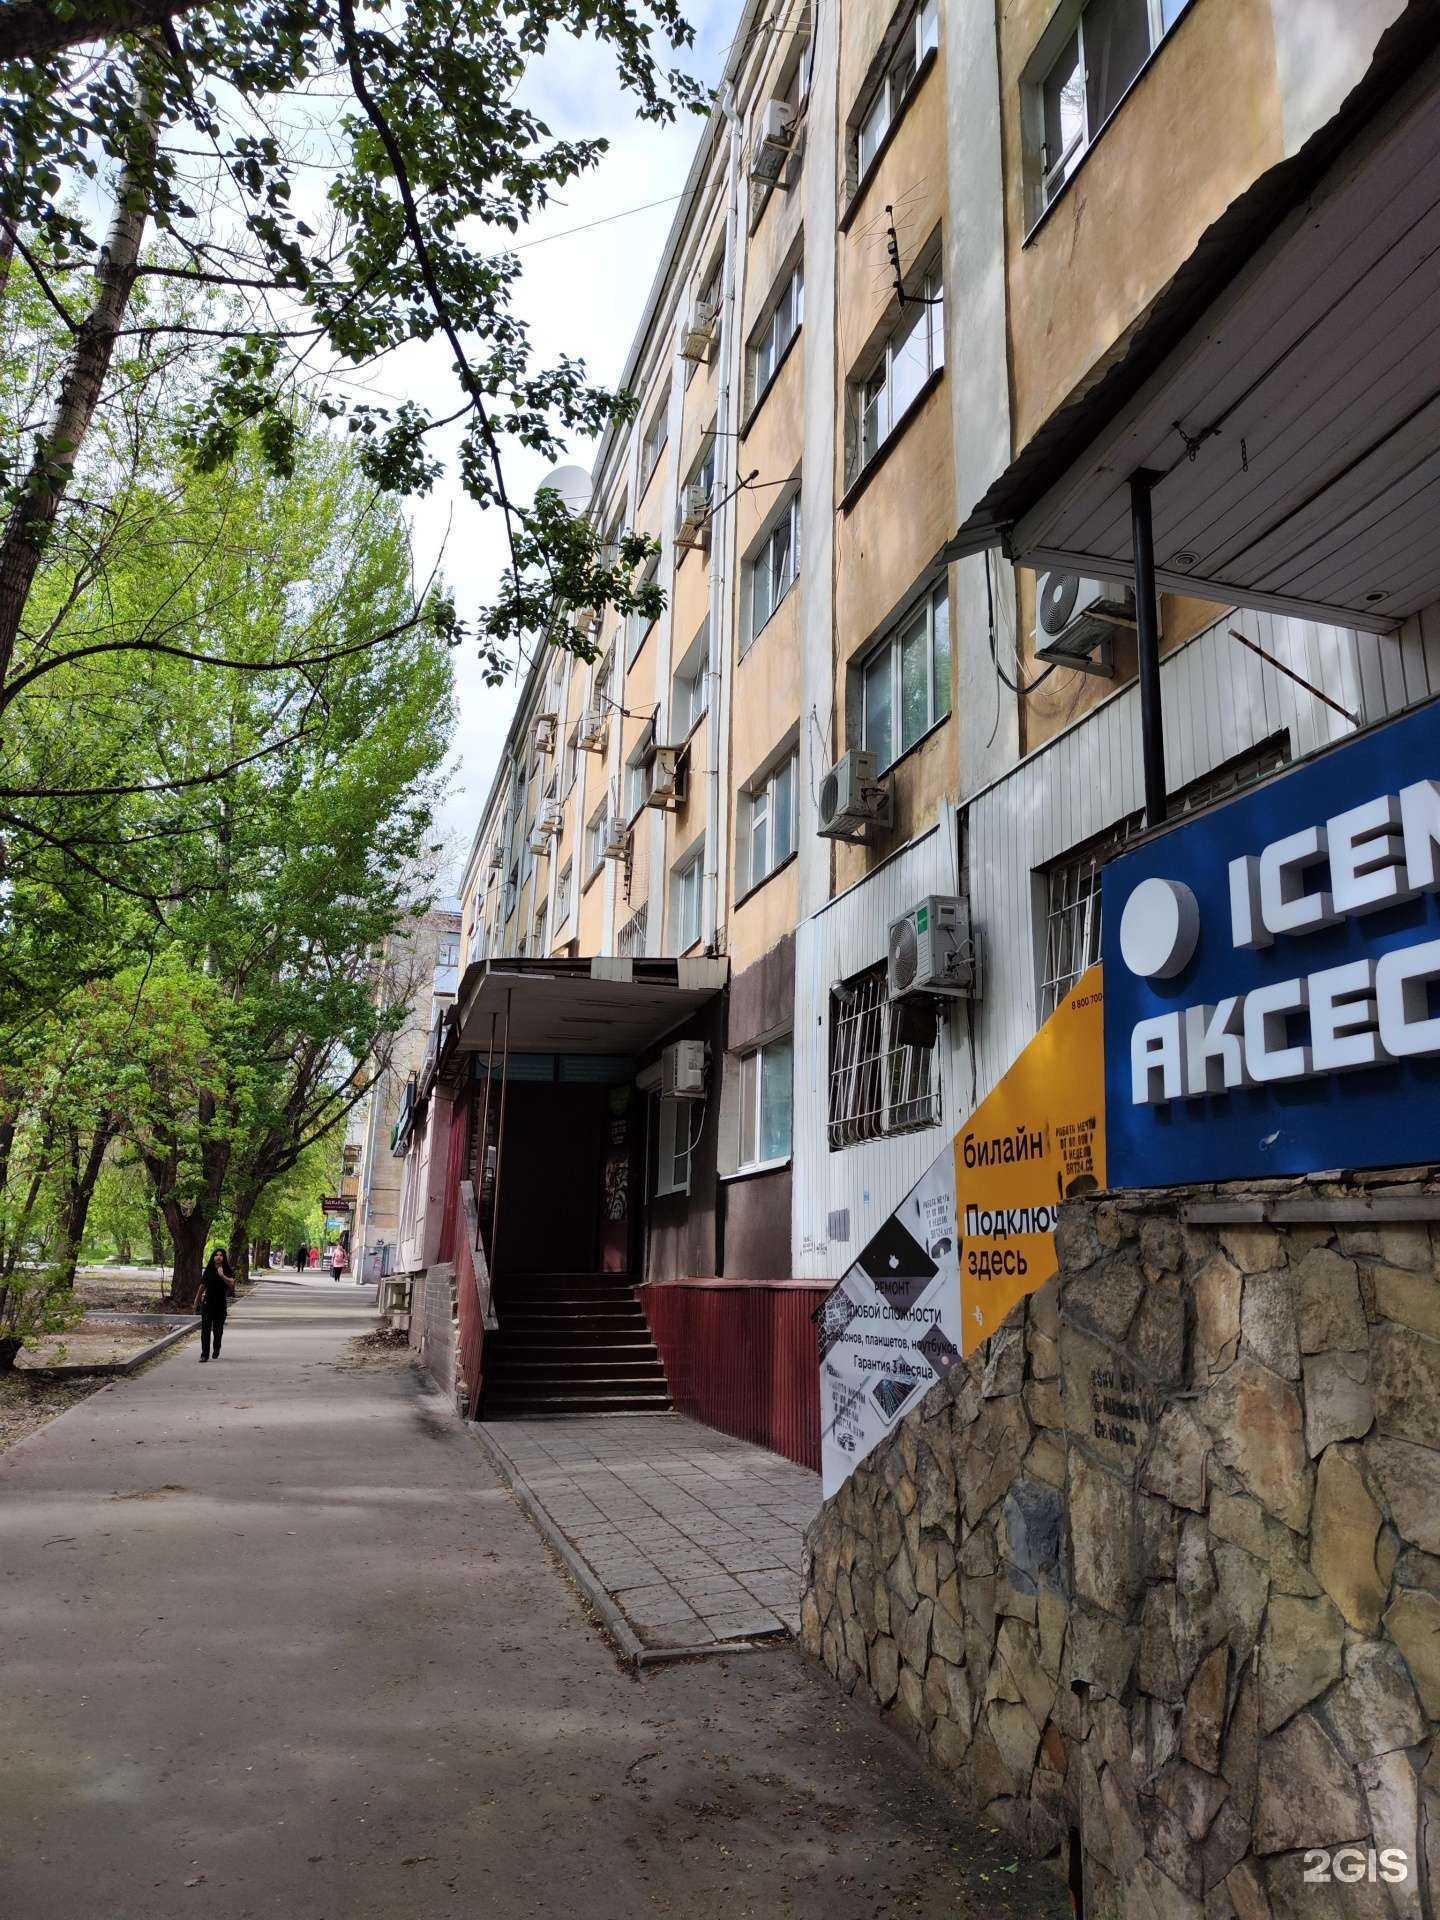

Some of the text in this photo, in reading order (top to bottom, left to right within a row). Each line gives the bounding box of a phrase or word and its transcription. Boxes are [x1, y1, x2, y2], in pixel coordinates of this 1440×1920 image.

[964, 1126, 1043, 1168] билайн
[968, 1250, 1028, 1280] здесь
[874, 1281, 910, 1296] РЕМОНТ
[850, 1303, 880, 1319] ЛЮБОЙ
[882, 1306, 942, 1323] СЛОЖНОСТИ
[865, 1334, 910, 1351] планшетов,
[911, 1338, 958, 1356] ноутбуков
[853, 1354, 890, 1374] Гарантия
[892, 1360, 899, 1374] 3
[900, 1363, 933, 1379] месяца
